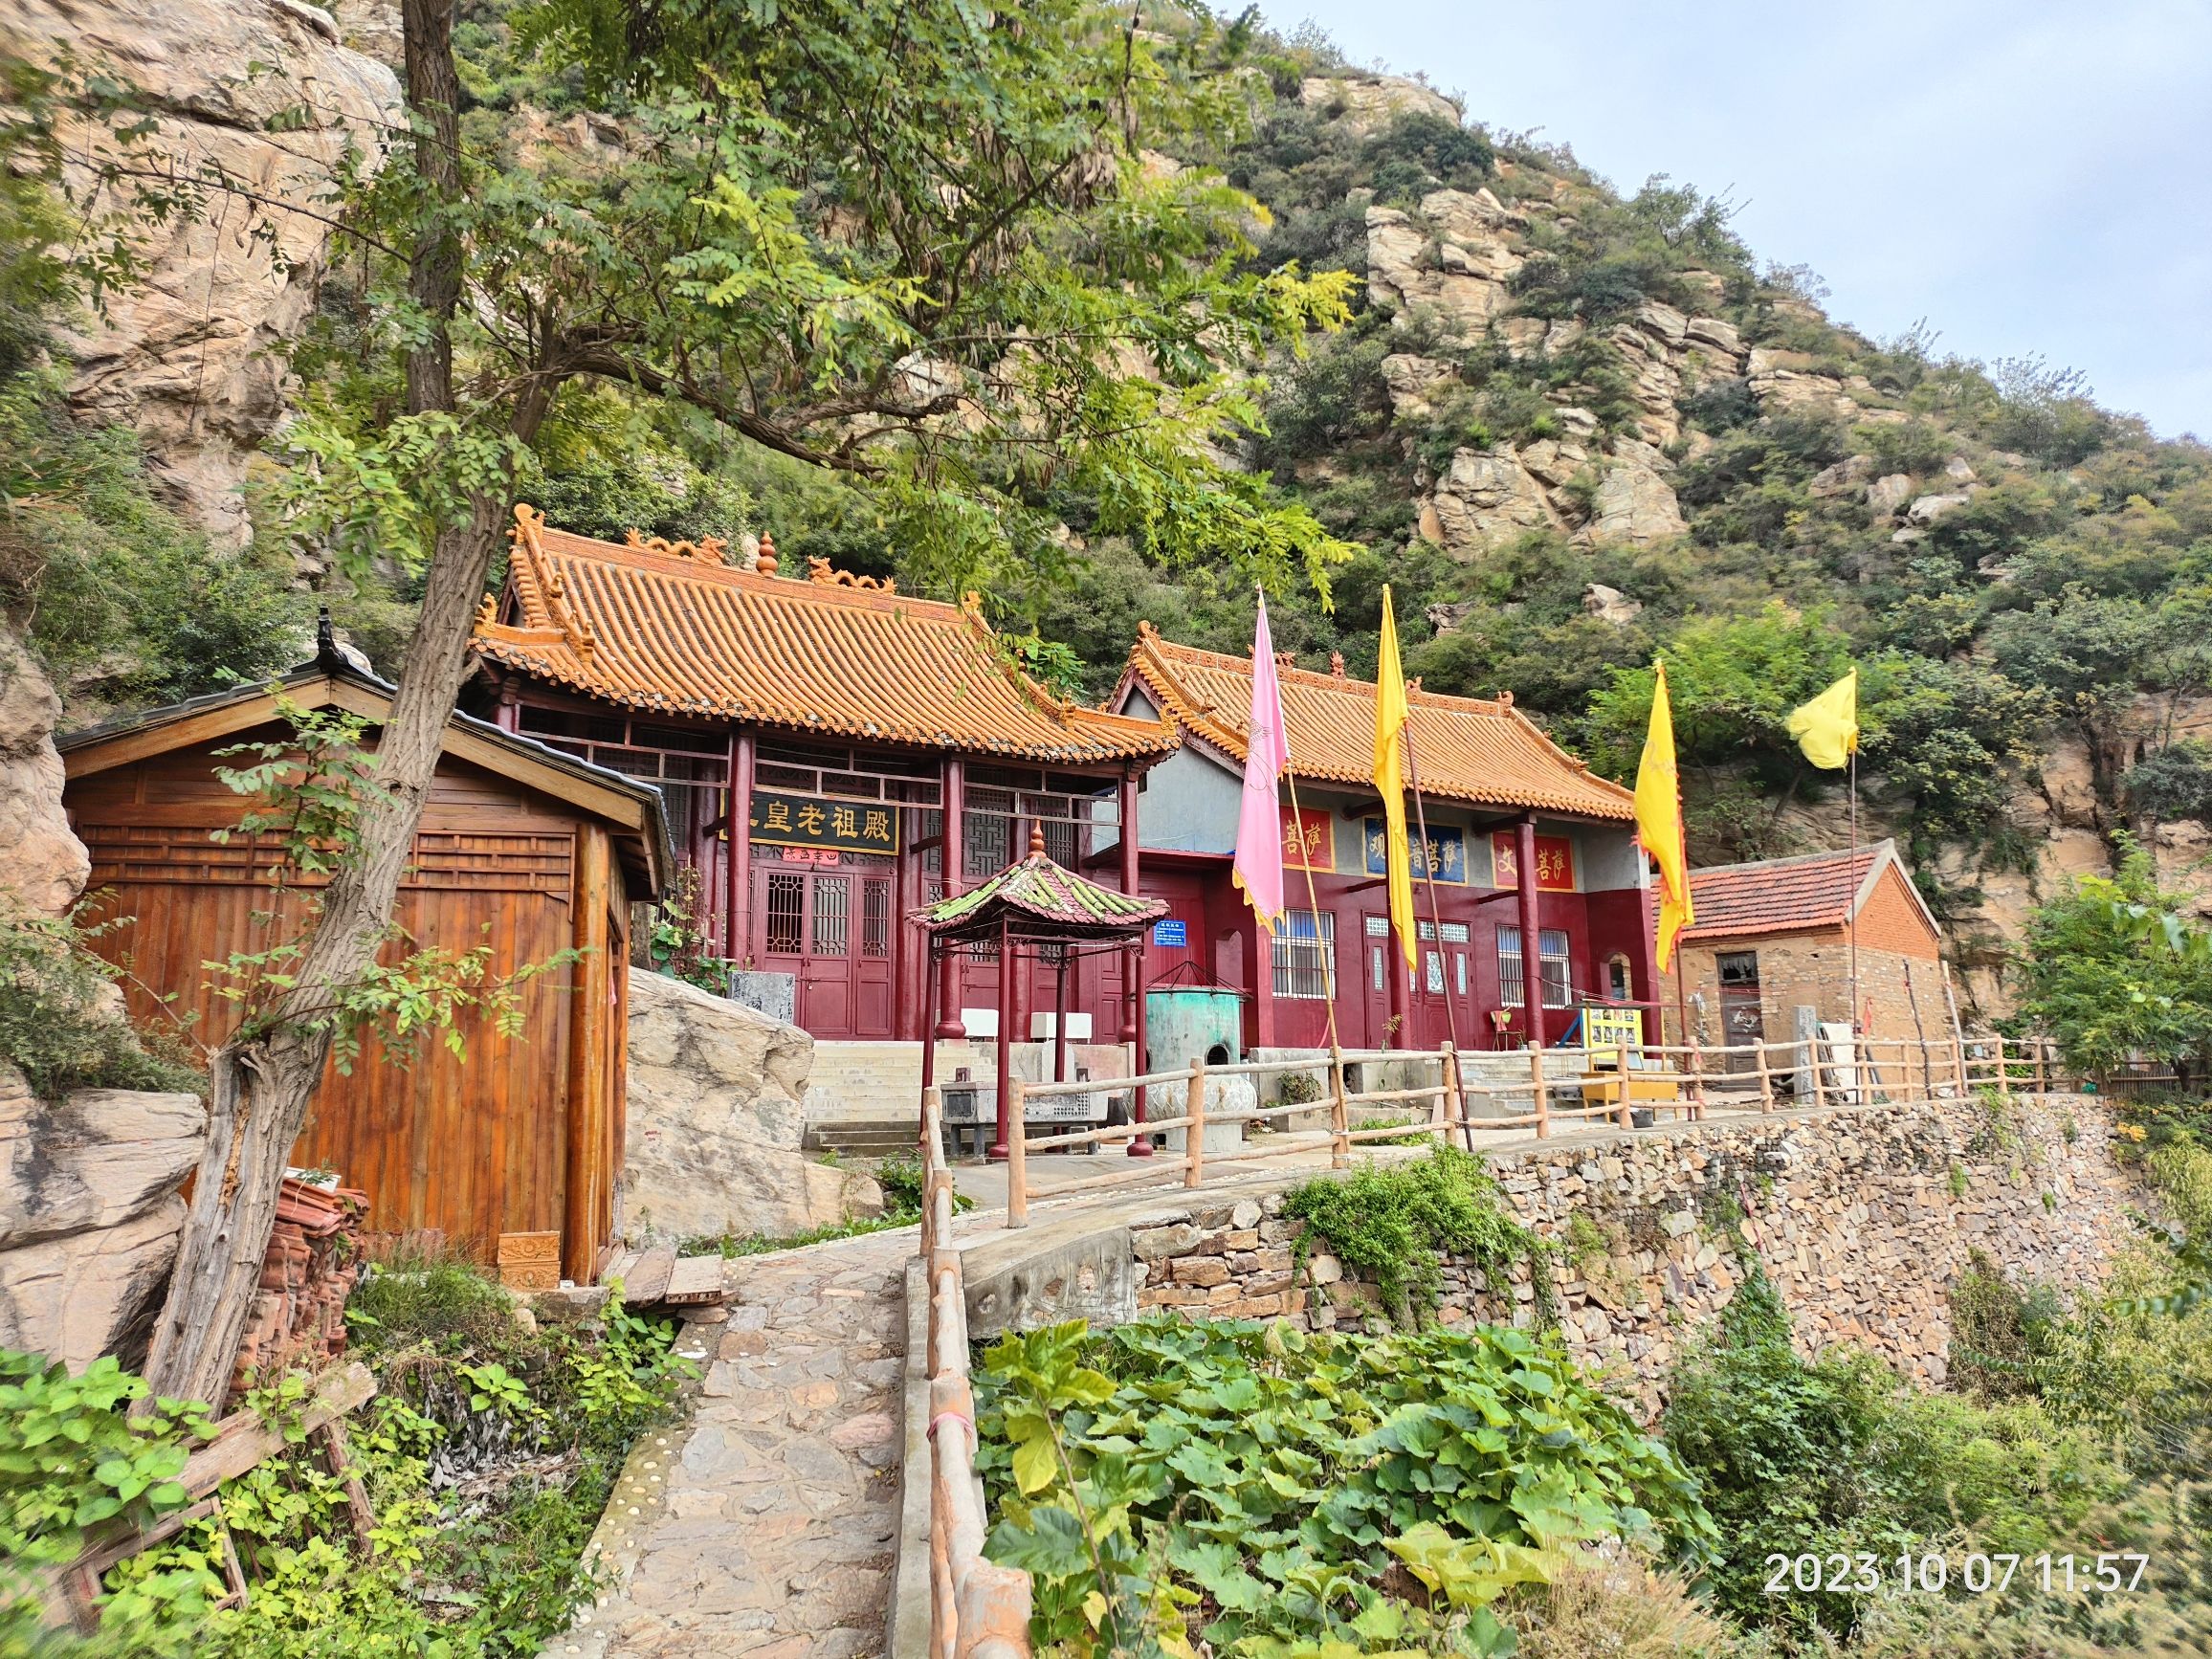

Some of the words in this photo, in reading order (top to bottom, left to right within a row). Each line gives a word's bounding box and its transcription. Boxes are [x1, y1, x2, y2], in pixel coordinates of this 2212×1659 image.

[749, 800, 890, 842] 皇老祖殿
[1282, 819, 1322, 856] 菩萨
[1369, 831, 1458, 874] 观音菩萨
[1497, 843, 1566, 881] 文菩萨
